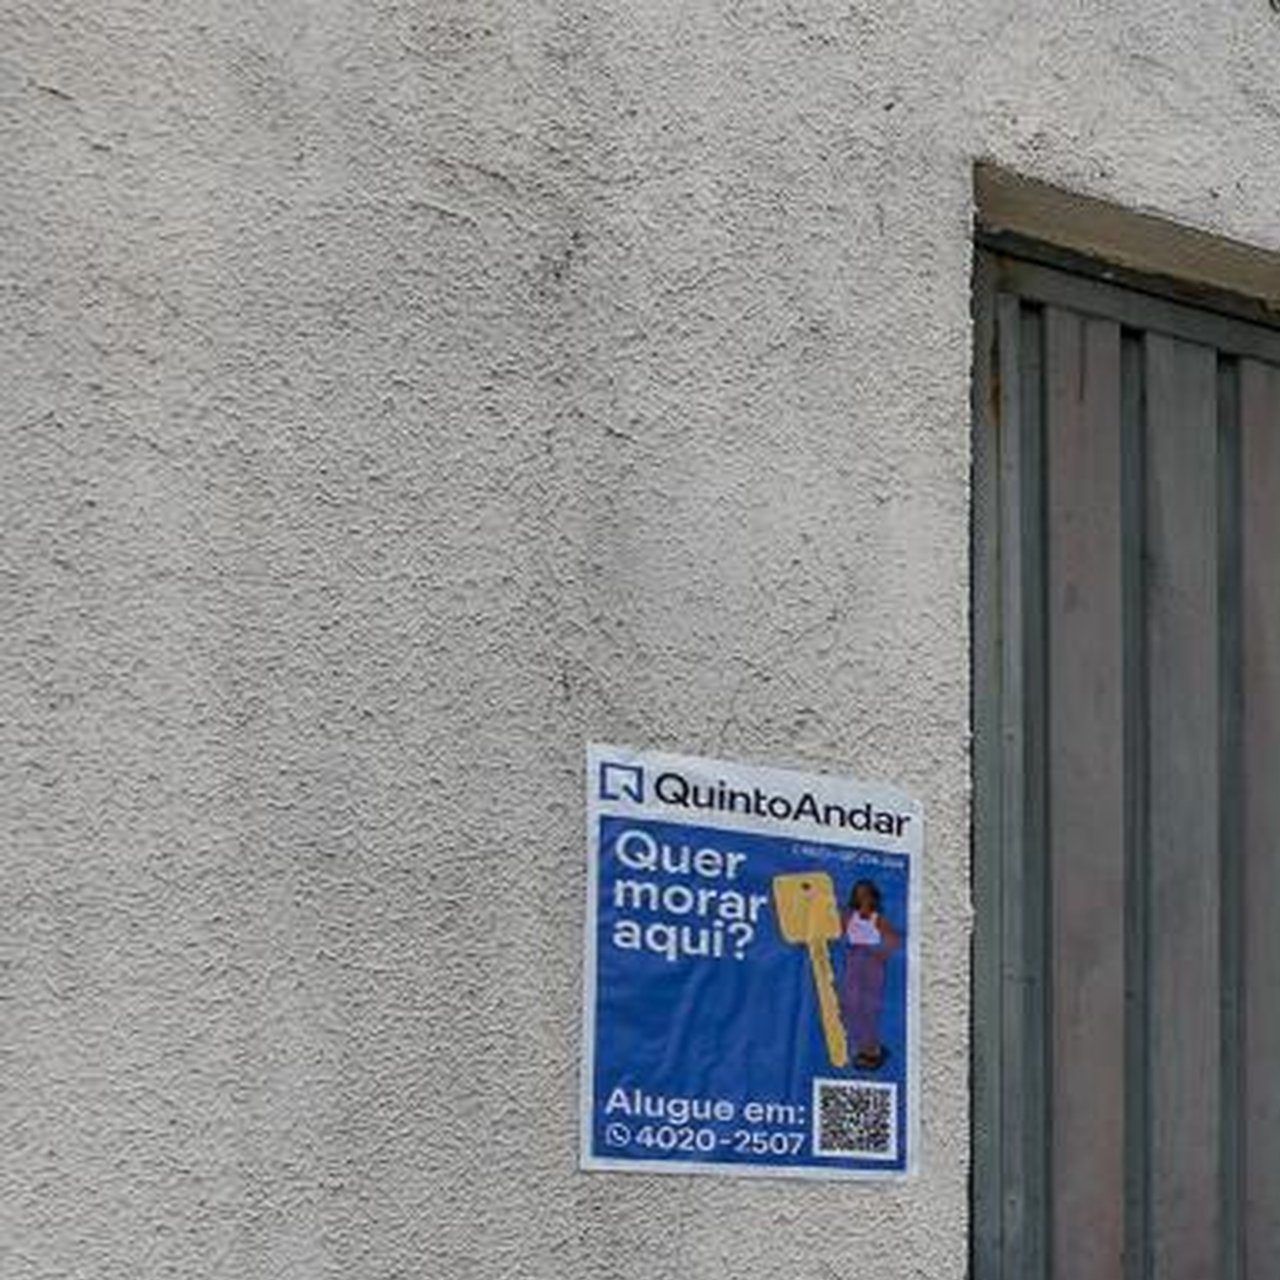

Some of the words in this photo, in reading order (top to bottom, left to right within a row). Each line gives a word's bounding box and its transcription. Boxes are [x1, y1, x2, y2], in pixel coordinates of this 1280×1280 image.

[654, 772, 911, 838] QuintoAndar
[614, 829, 747, 879] Quer
[612, 877, 768, 922] morar
[612, 918, 755, 961] aqui?
[605, 1087, 735, 1125] Alugue
[743, 1100, 806, 1125] em:
[635, 1125, 805, 1155] 4020-2507
